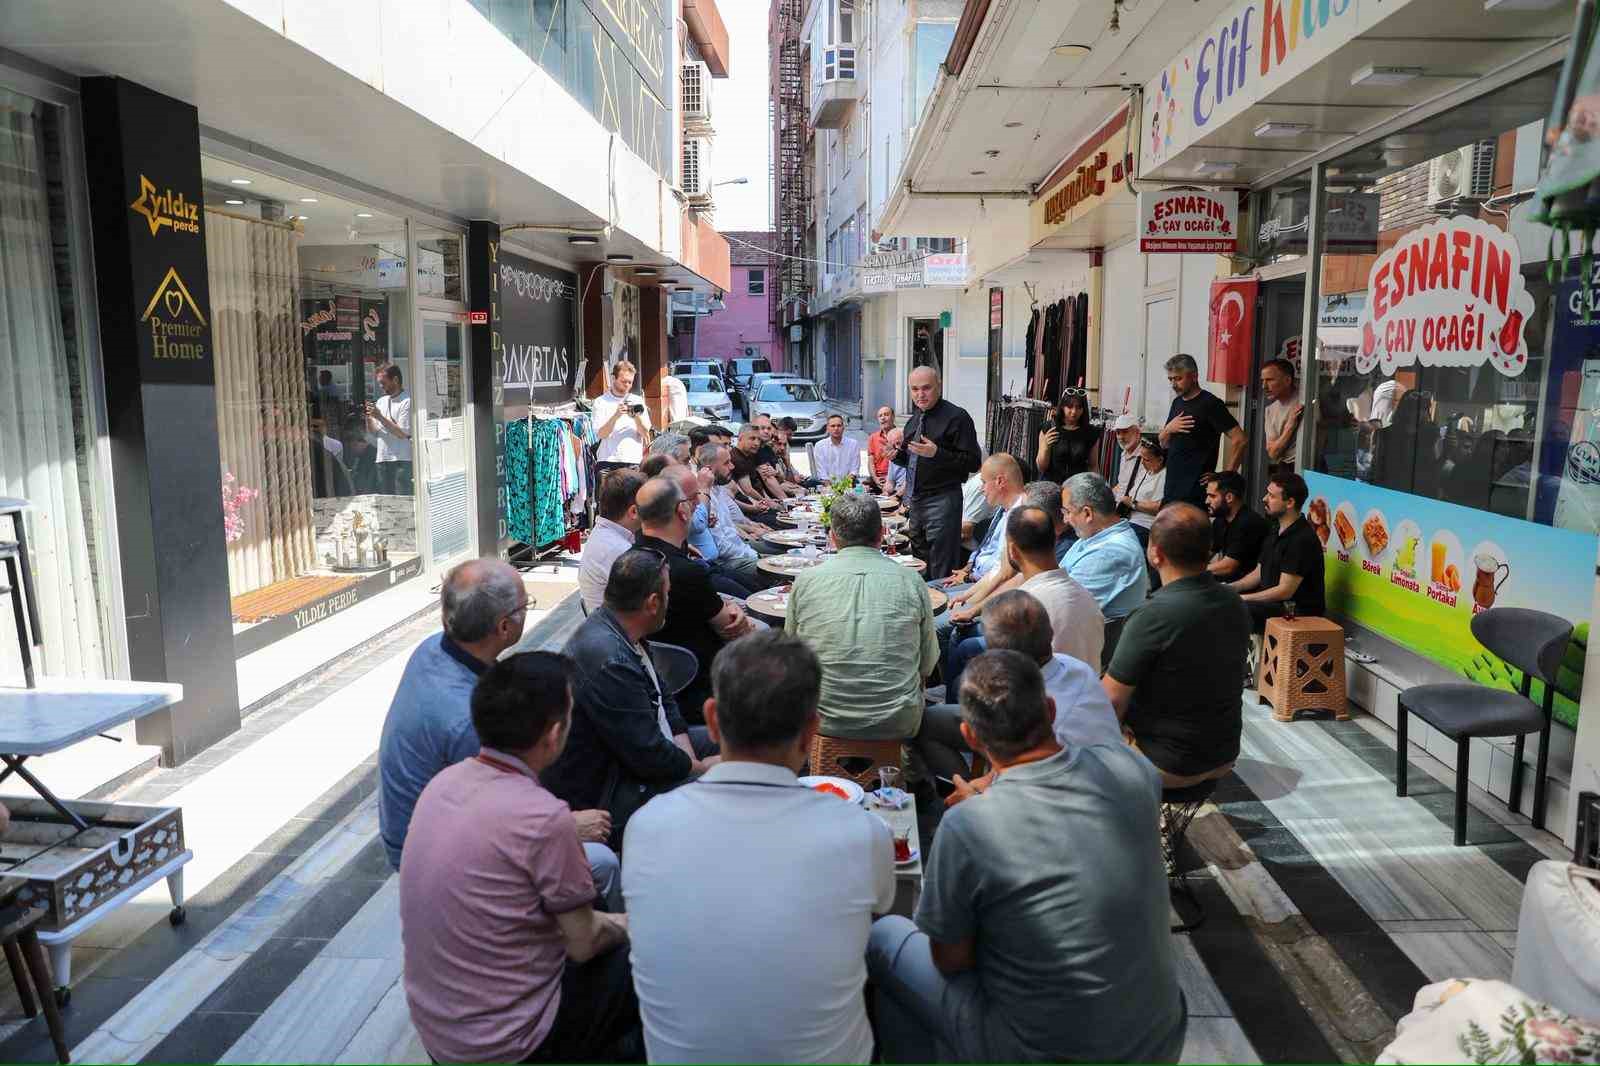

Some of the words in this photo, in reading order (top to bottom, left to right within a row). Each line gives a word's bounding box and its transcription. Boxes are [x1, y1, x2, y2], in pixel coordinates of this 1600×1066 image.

[1193, 6, 1255, 126] Elif
[1153, 195, 1225, 221] ESNAFIN
[174, 219, 200, 234] perde
[1184, 217, 1214, 232] OCAĞI
[1374, 231, 1511, 316] ESNAFIN
[151, 316, 201, 338] Premier
[1385, 318, 1417, 361] ÇAY
[1422, 303, 1485, 352] OCAĞI
[153, 335, 205, 360] Home
[1362, 560, 1381, 576] Börek
[1391, 571, 1420, 593] Limonata
[1427, 586, 1457, 608] Portakal
[294, 602, 328, 630] YILDIZ
[328, 589, 358, 614] PERDE
